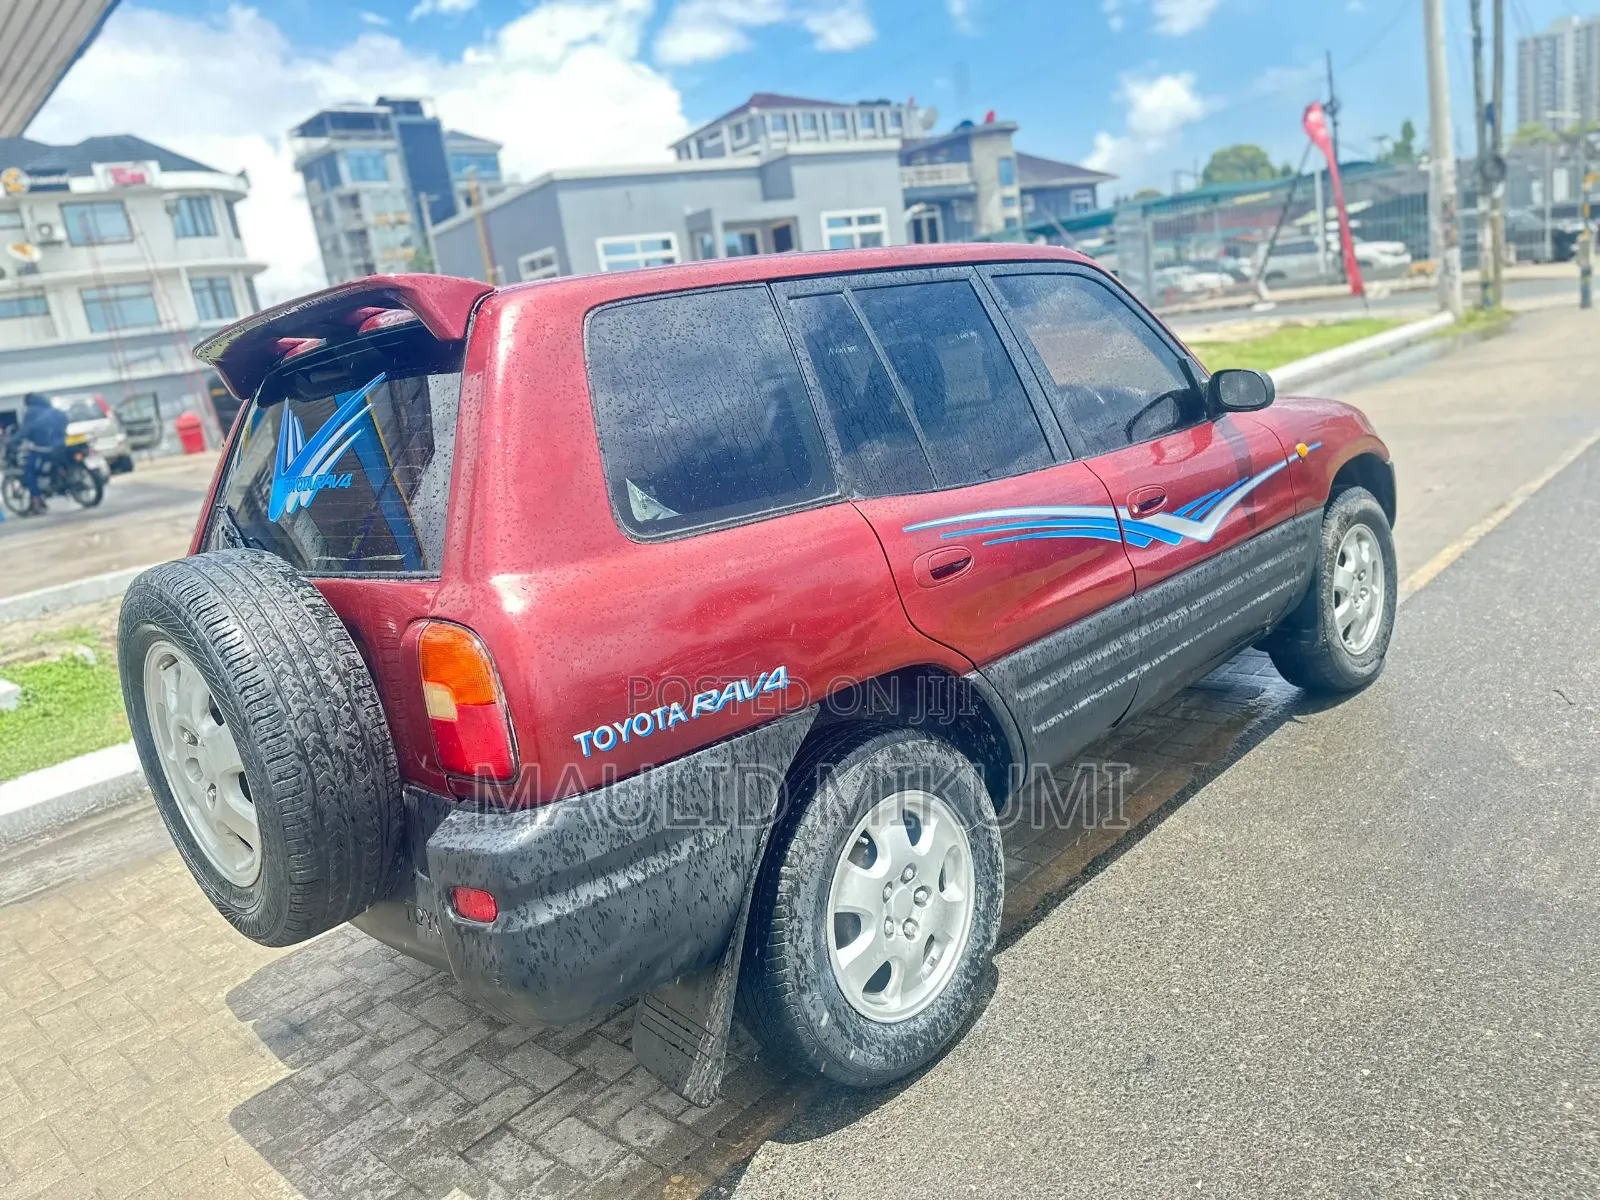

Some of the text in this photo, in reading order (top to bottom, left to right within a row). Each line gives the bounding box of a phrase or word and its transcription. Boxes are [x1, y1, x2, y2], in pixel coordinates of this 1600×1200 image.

[284, 473, 353, 494] TOYOTA RAV4
[573, 665, 790, 758] TOYOTA RAV4
